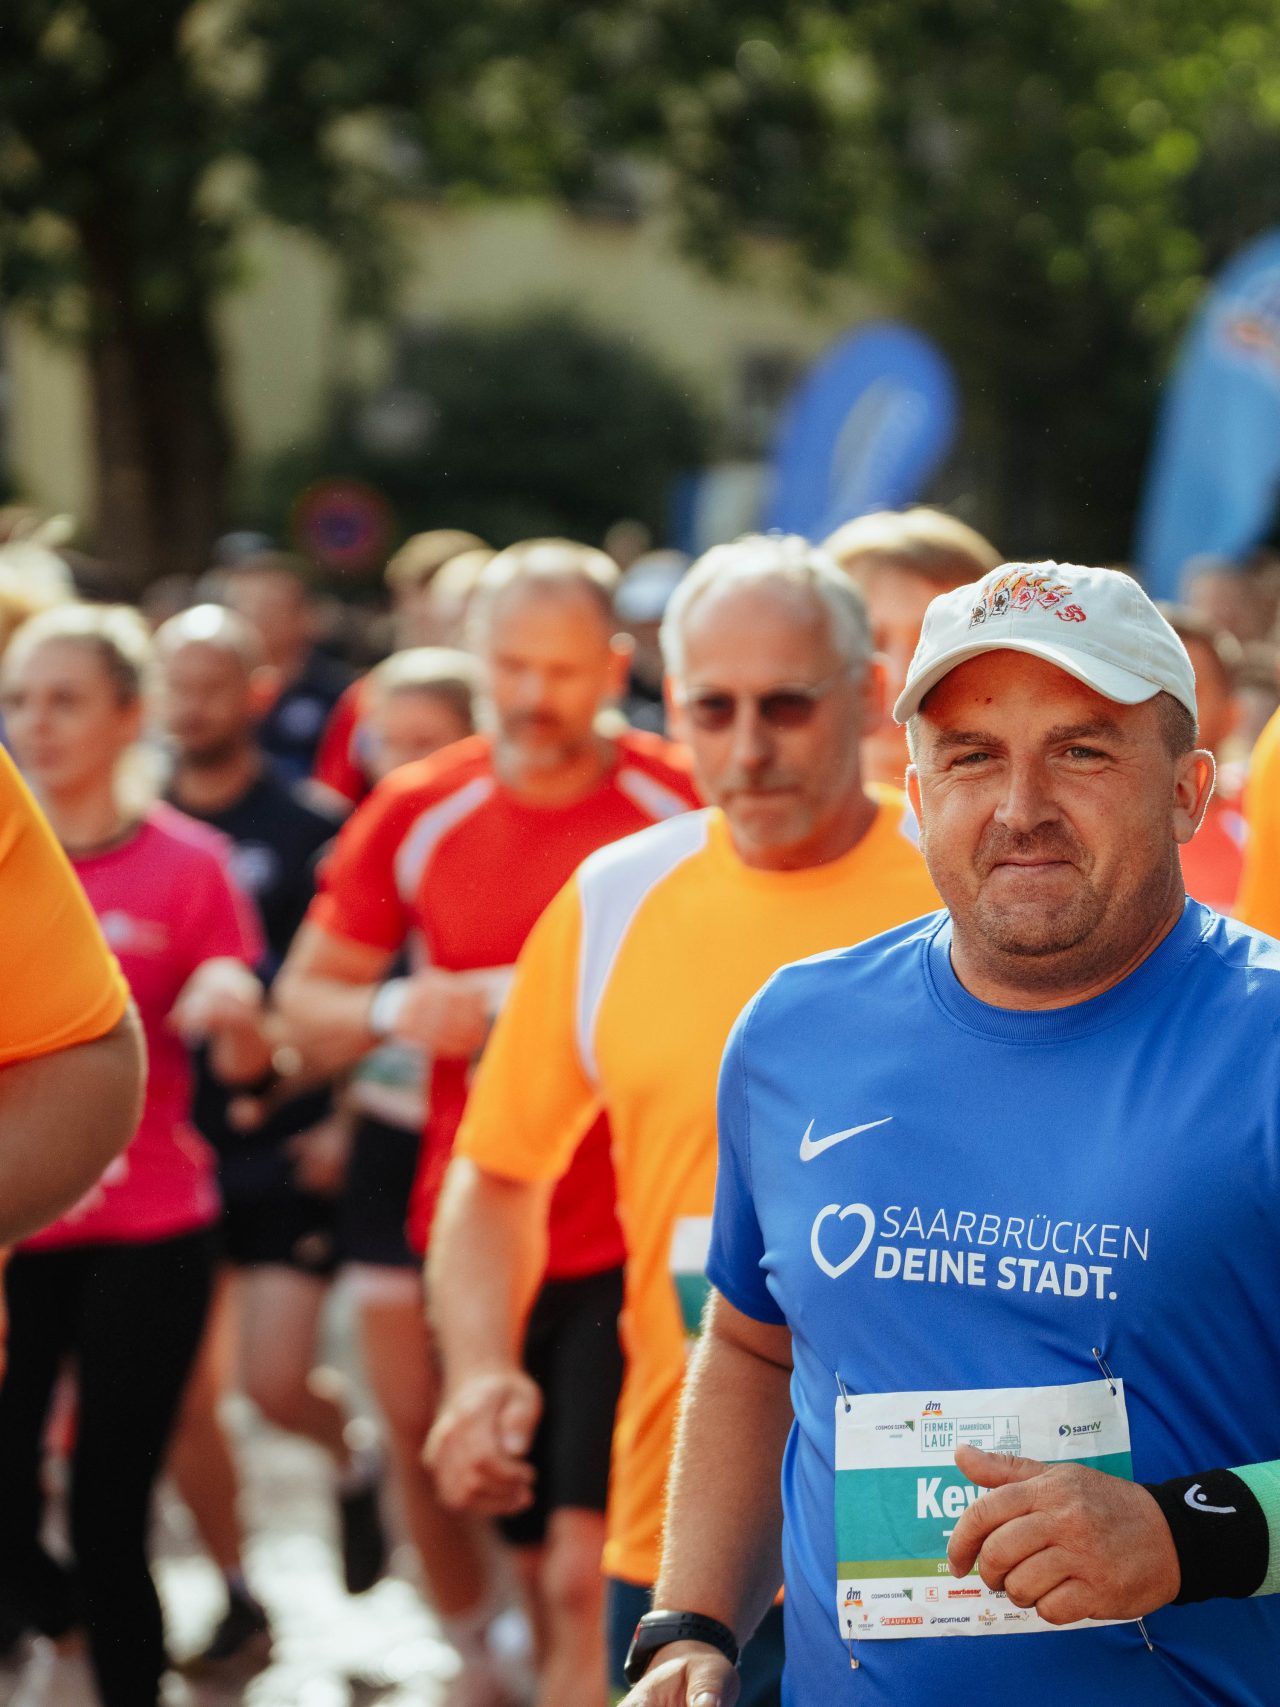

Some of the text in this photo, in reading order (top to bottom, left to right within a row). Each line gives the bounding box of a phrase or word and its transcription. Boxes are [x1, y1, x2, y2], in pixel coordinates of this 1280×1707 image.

[880, 1205, 1149, 1261] SAARBRÜCKEN
[874, 1246, 1117, 1300] DEINE STADT.
[925, 1401, 941, 1411] dm
[924, 1422, 954, 1432] FIRMEN
[924, 1434, 953, 1448] LAUF
[846, 1587, 861, 1600] dm
[885, 1617, 923, 1625] BAUHAUS
[937, 1616, 970, 1624] DECATHLON
